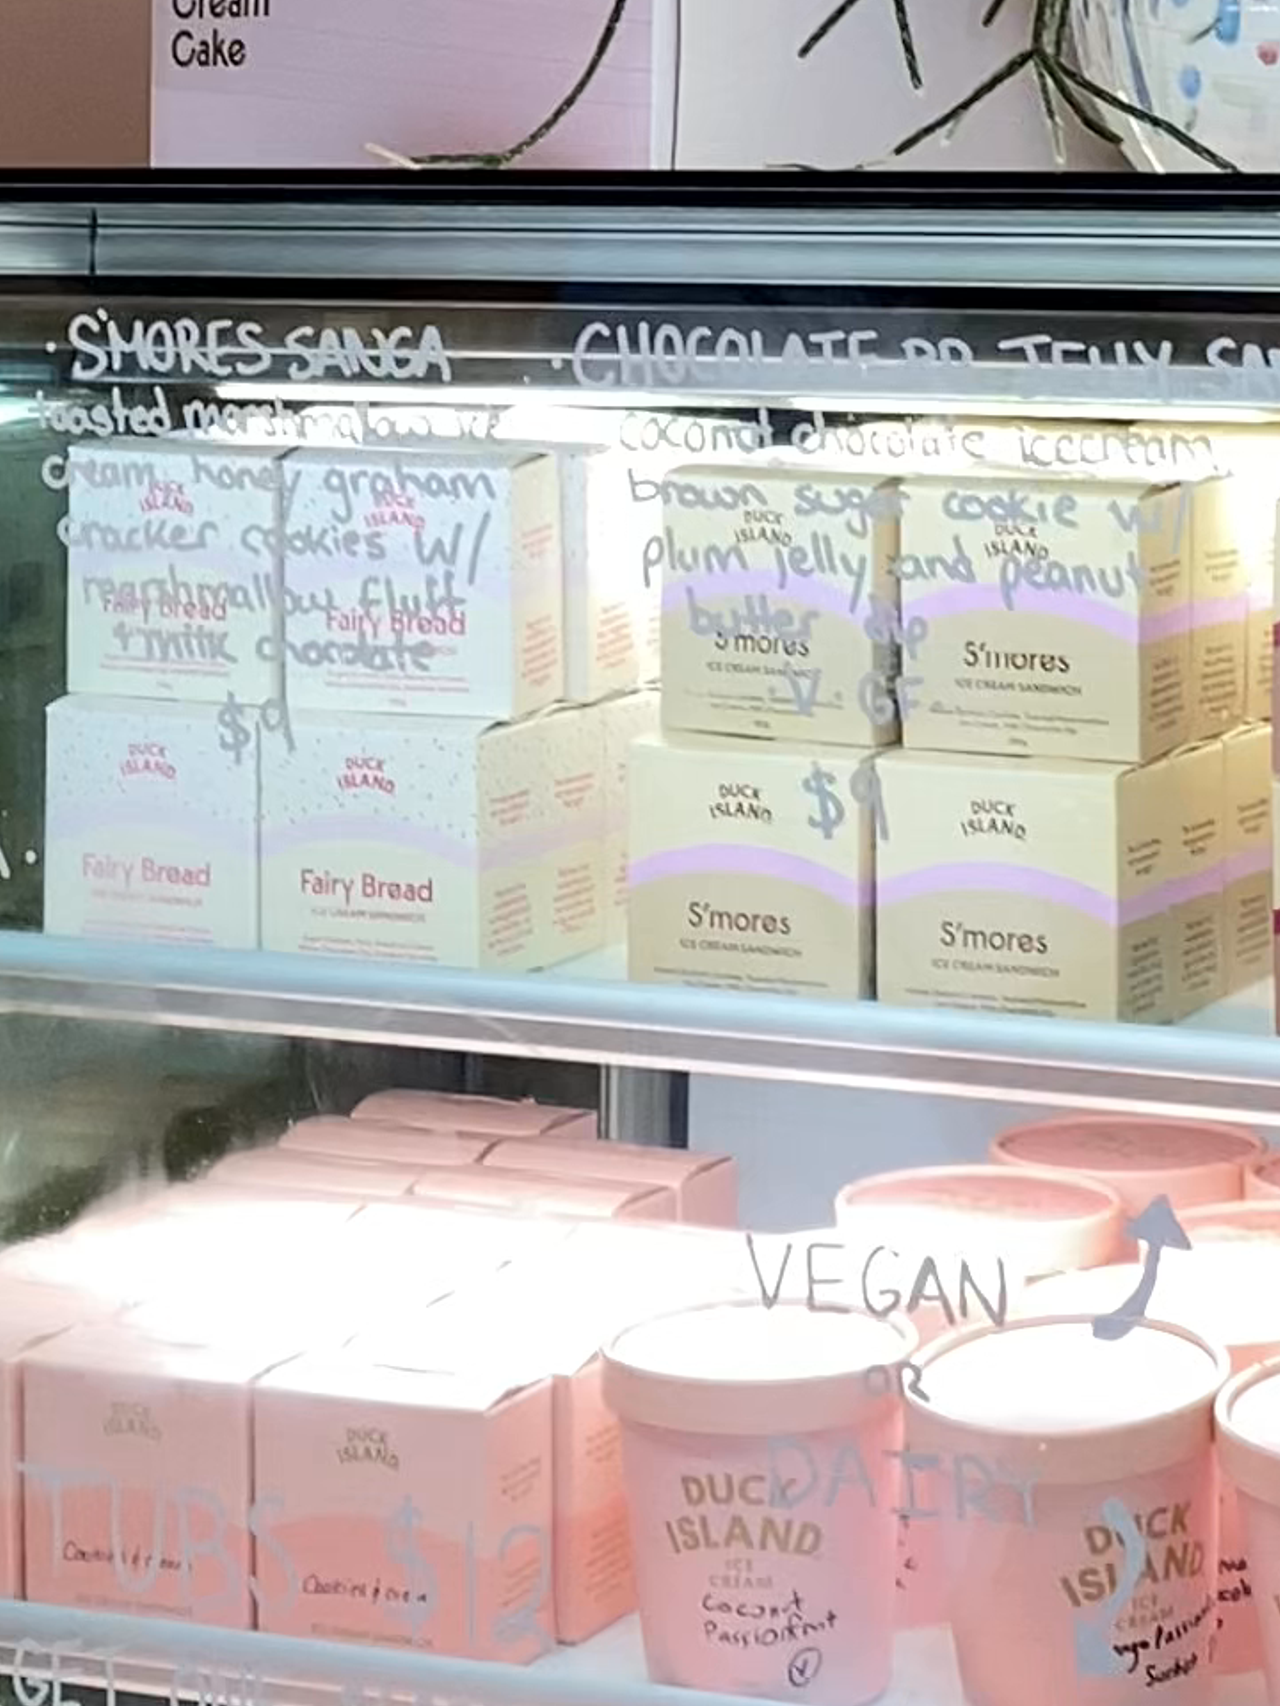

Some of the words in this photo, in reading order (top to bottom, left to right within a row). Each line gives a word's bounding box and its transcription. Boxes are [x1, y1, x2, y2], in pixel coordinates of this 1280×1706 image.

[171, 30, 247, 67] Cake
[285, 324, 452, 383] SANGA
[35, 385, 172, 436] toasted
[619, 406, 774, 454] coconut
[193, 453, 302, 522] honey
[323, 462, 496, 524] graham
[627, 467, 769, 511] brown
[942, 488, 1080, 529] cookie
[55, 514, 220, 552] cracker
[241, 523, 387, 560] cookies
[642, 524, 749, 589] plum
[773, 530, 868, 615] jelly
[885, 533, 977, 584] and
[1000, 549, 1148, 612] peanut
[390, 609, 467, 637] Bread
[685, 585, 820, 638] butter
[218, 690, 297, 766] $9
[119, 758, 178, 784] ISLAND
[344, 754, 385, 773] DUCK
[336, 771, 397, 797] ISLAND
[718, 782, 761, 802] DUCK
[801, 759, 890, 842] $9
[707, 800, 773, 825] ISLAND
[969, 798, 1017, 818] DUCK
[960, 816, 1028, 842] ISLAND
[80, 850, 135, 885] Fairy
[140, 854, 213, 888] Bread
[299, 867, 356, 907] Fairy
[360, 872, 435, 904] Bread
[687, 901, 793, 937] S'mores
[938, 920, 1050, 957] S'mores
[745, 1232, 1008, 1329] VEGAN
[862, 1360, 931, 1404] OR
[345, 1426, 389, 1446] DUCK
[335, 1445, 401, 1472] ISLAND
[680, 1472, 798, 1510] DUCK
[15, 1460, 300, 1618] TUBS
[663, 1512, 825, 1558] ISLAND
